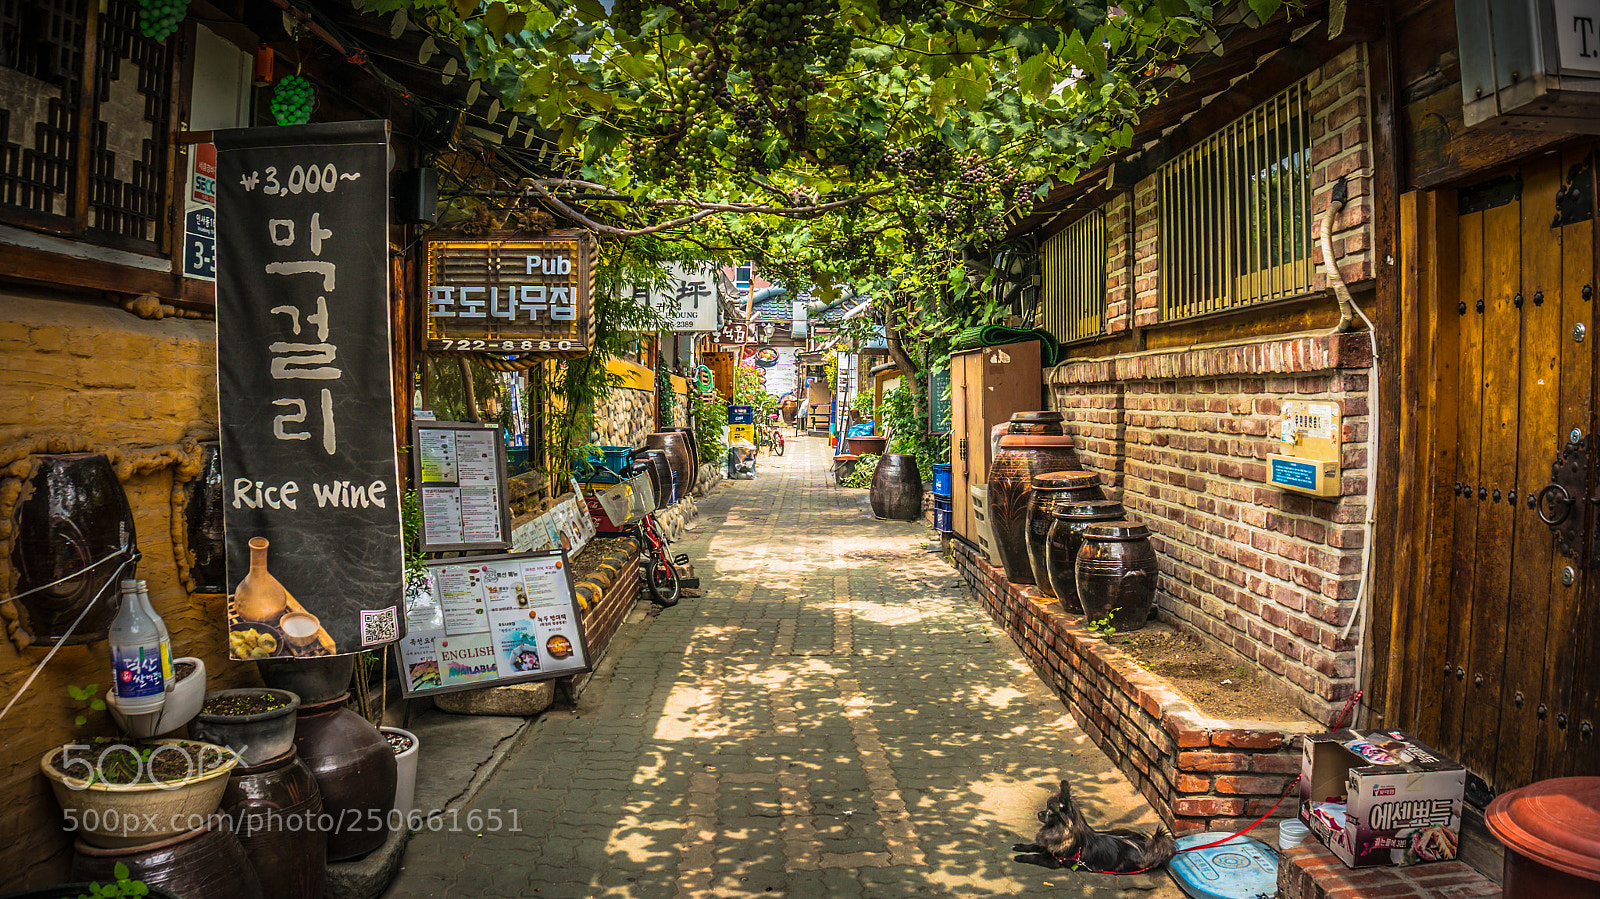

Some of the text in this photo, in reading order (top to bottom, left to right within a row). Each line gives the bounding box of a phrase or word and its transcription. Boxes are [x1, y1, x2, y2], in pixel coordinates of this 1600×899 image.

[526, 255, 572, 275] Pub
[429, 285, 577, 321] 포도나무집
[265, 212, 343, 455] 막걸리
[442, 339, 573, 351] 722-8880
[232, 477, 299, 510] Rice
[441, 645, 496, 662] ENGLISH
[1370, 800, 1453, 830] 에센뽀득
